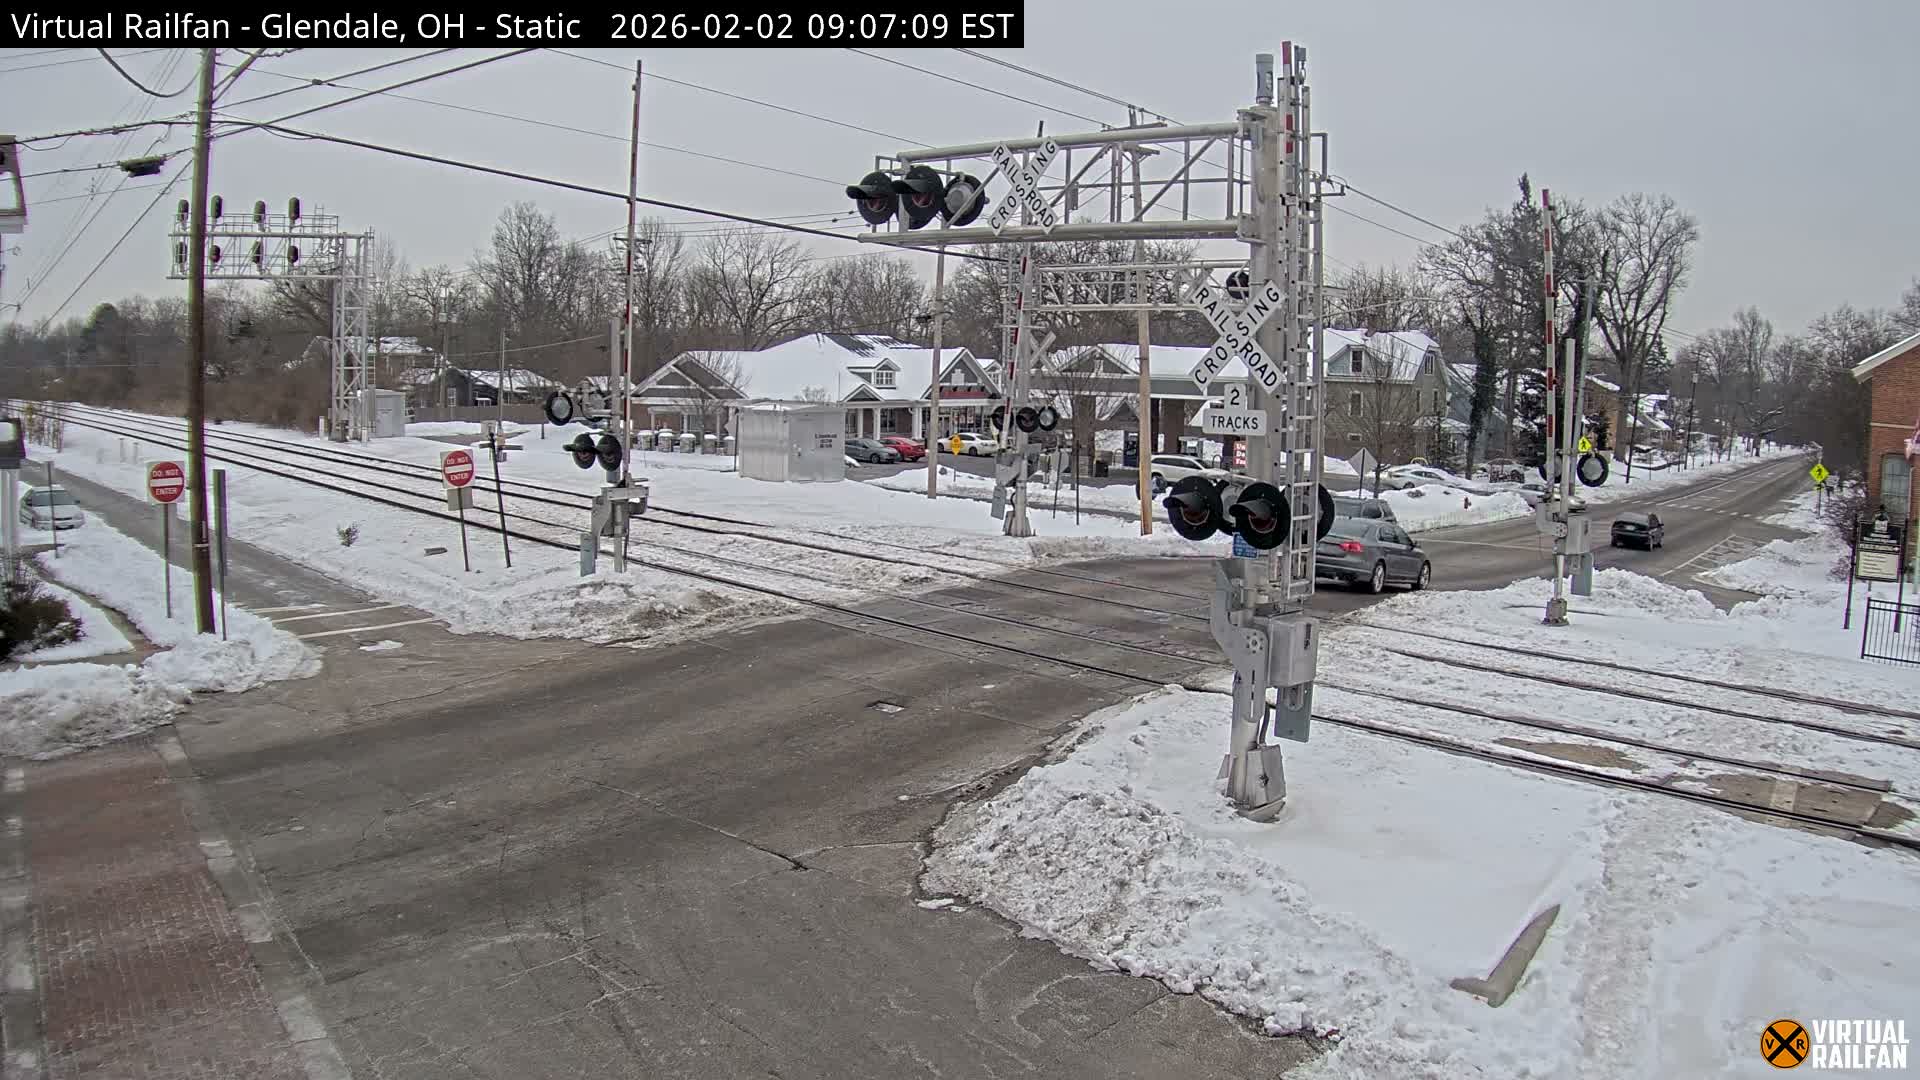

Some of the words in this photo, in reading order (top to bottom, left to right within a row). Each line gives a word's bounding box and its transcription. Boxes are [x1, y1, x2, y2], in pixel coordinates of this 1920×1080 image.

[991, 141, 1056, 229] CROSSING
[1194, 287, 1280, 384] CROSSING
[1230, 388, 1241, 406] 2
[1211, 415, 1259, 430] TRACKS
[152, 470, 161, 478] DO
[450, 473, 469, 481] ENTER
[155, 487, 178, 496] ENTER
